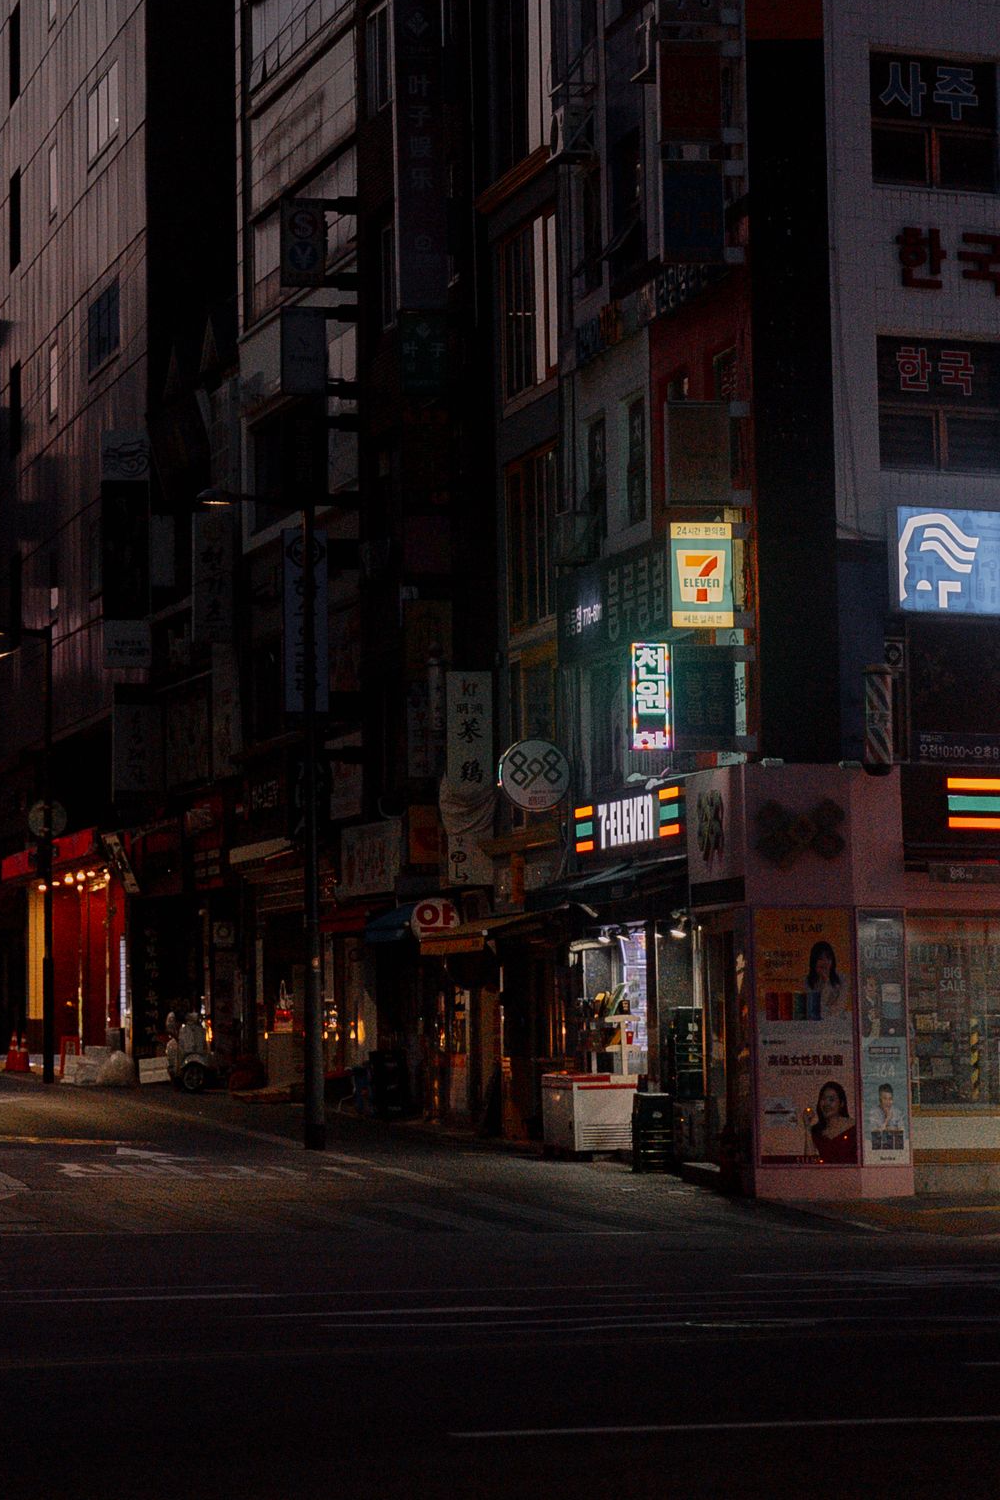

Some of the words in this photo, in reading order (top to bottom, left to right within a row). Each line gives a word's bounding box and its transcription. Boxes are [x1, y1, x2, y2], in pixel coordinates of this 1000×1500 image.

[879, 60, 978, 121] 사주
[896, 347, 974, 396] 한국
[635, 647, 666, 715] 천원
[939, 980, 967, 992] SALE
[943, 967, 962, 978] BIG
